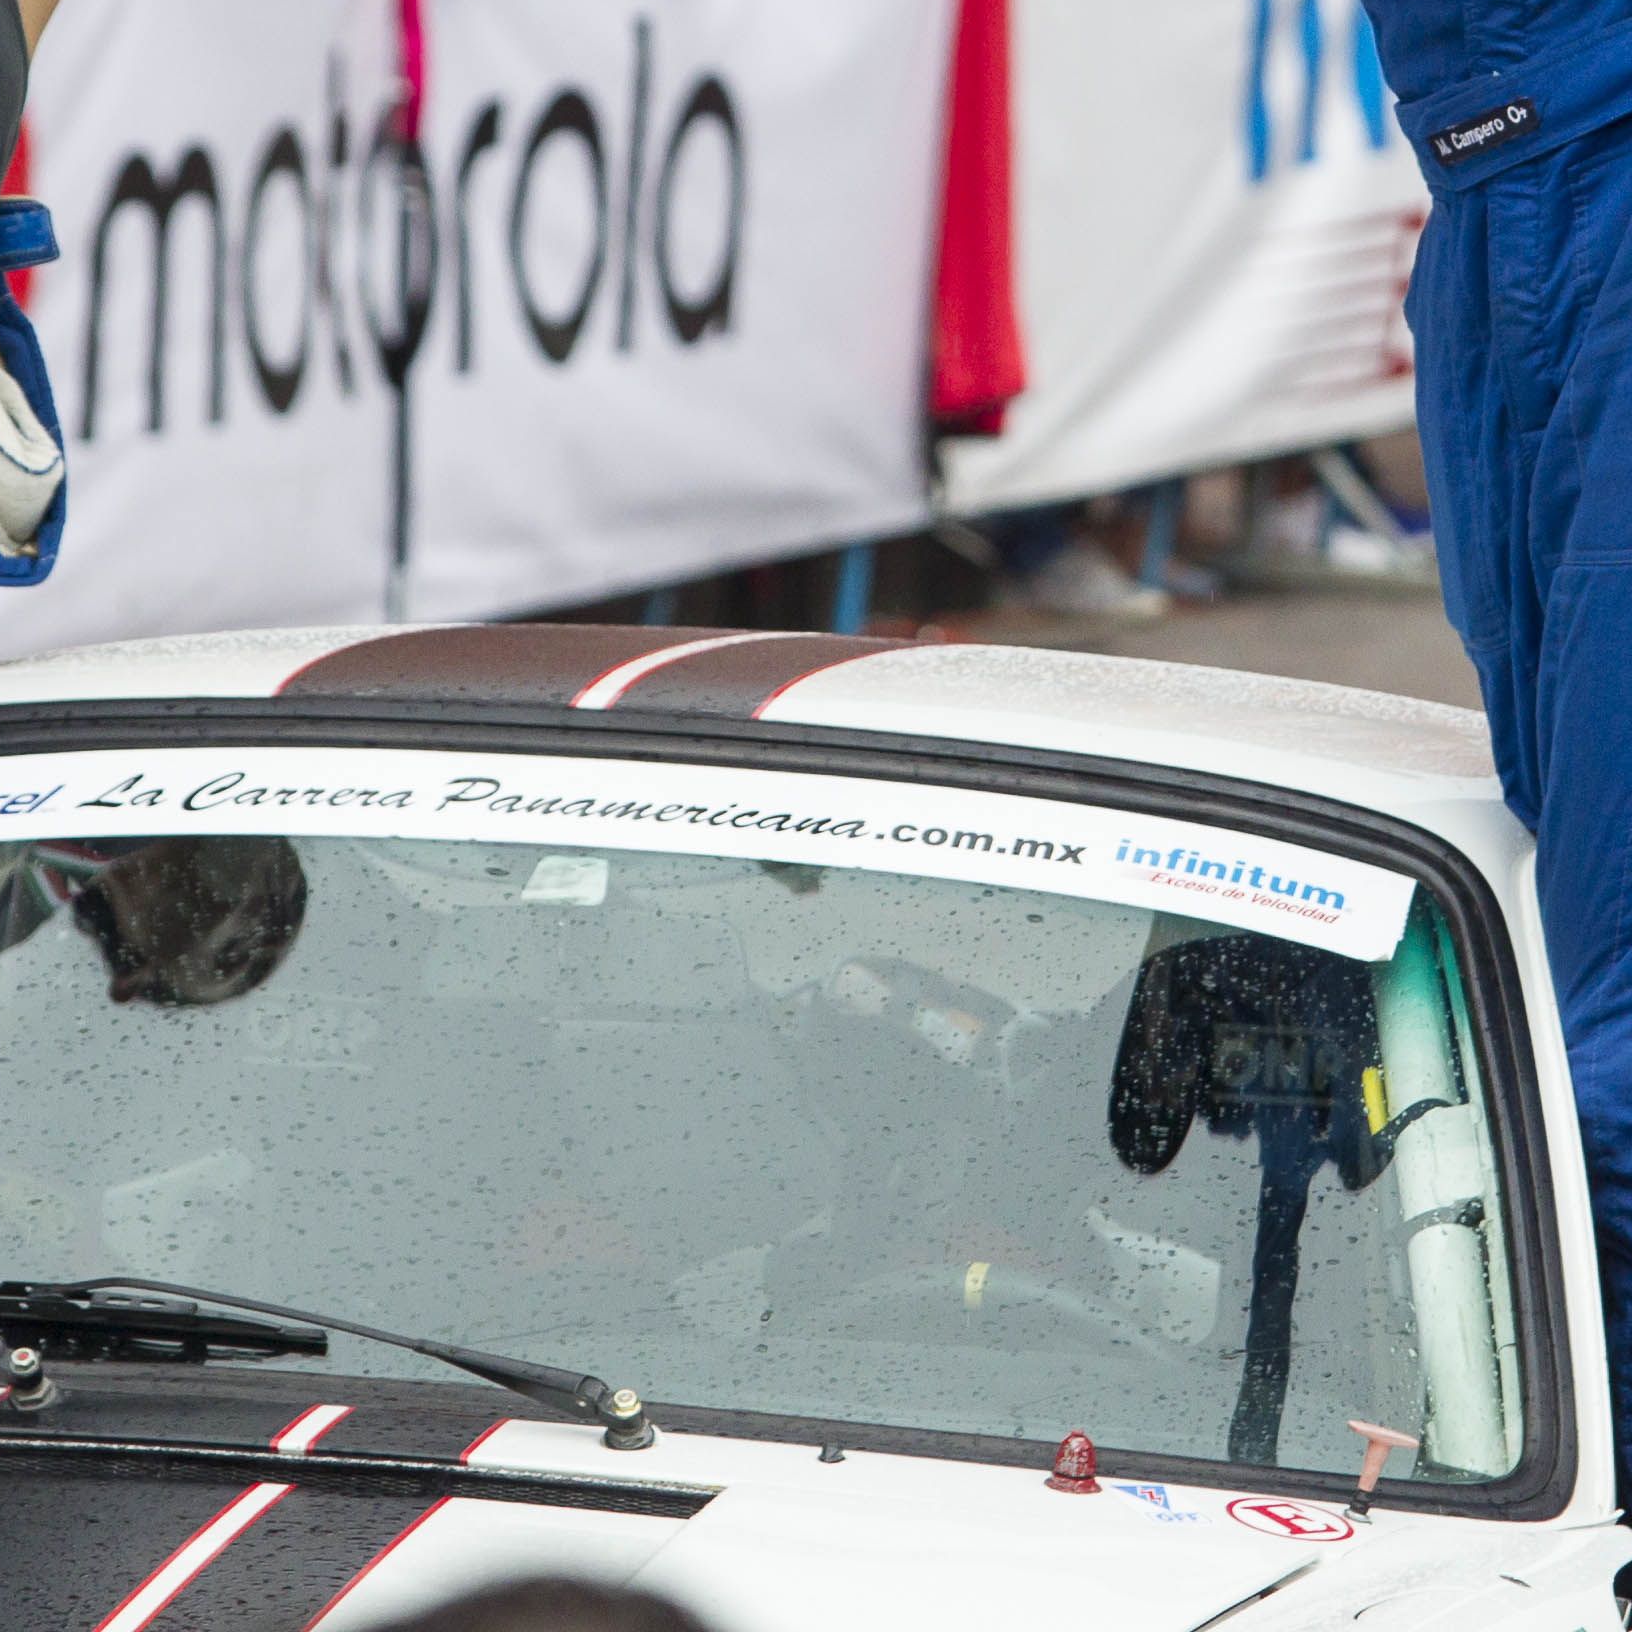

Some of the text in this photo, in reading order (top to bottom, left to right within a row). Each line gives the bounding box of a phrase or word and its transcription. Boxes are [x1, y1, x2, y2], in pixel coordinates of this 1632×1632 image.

[1450, 118, 1505, 150] Campero
[76, 13, 753, 441] motorola
[75, 772, 167, 809] La
[181, 771, 416, 811] Carrera
[1114, 838, 1346, 911] infinitum
[1151, 871, 1341, 925] Exceso de Velocidad
